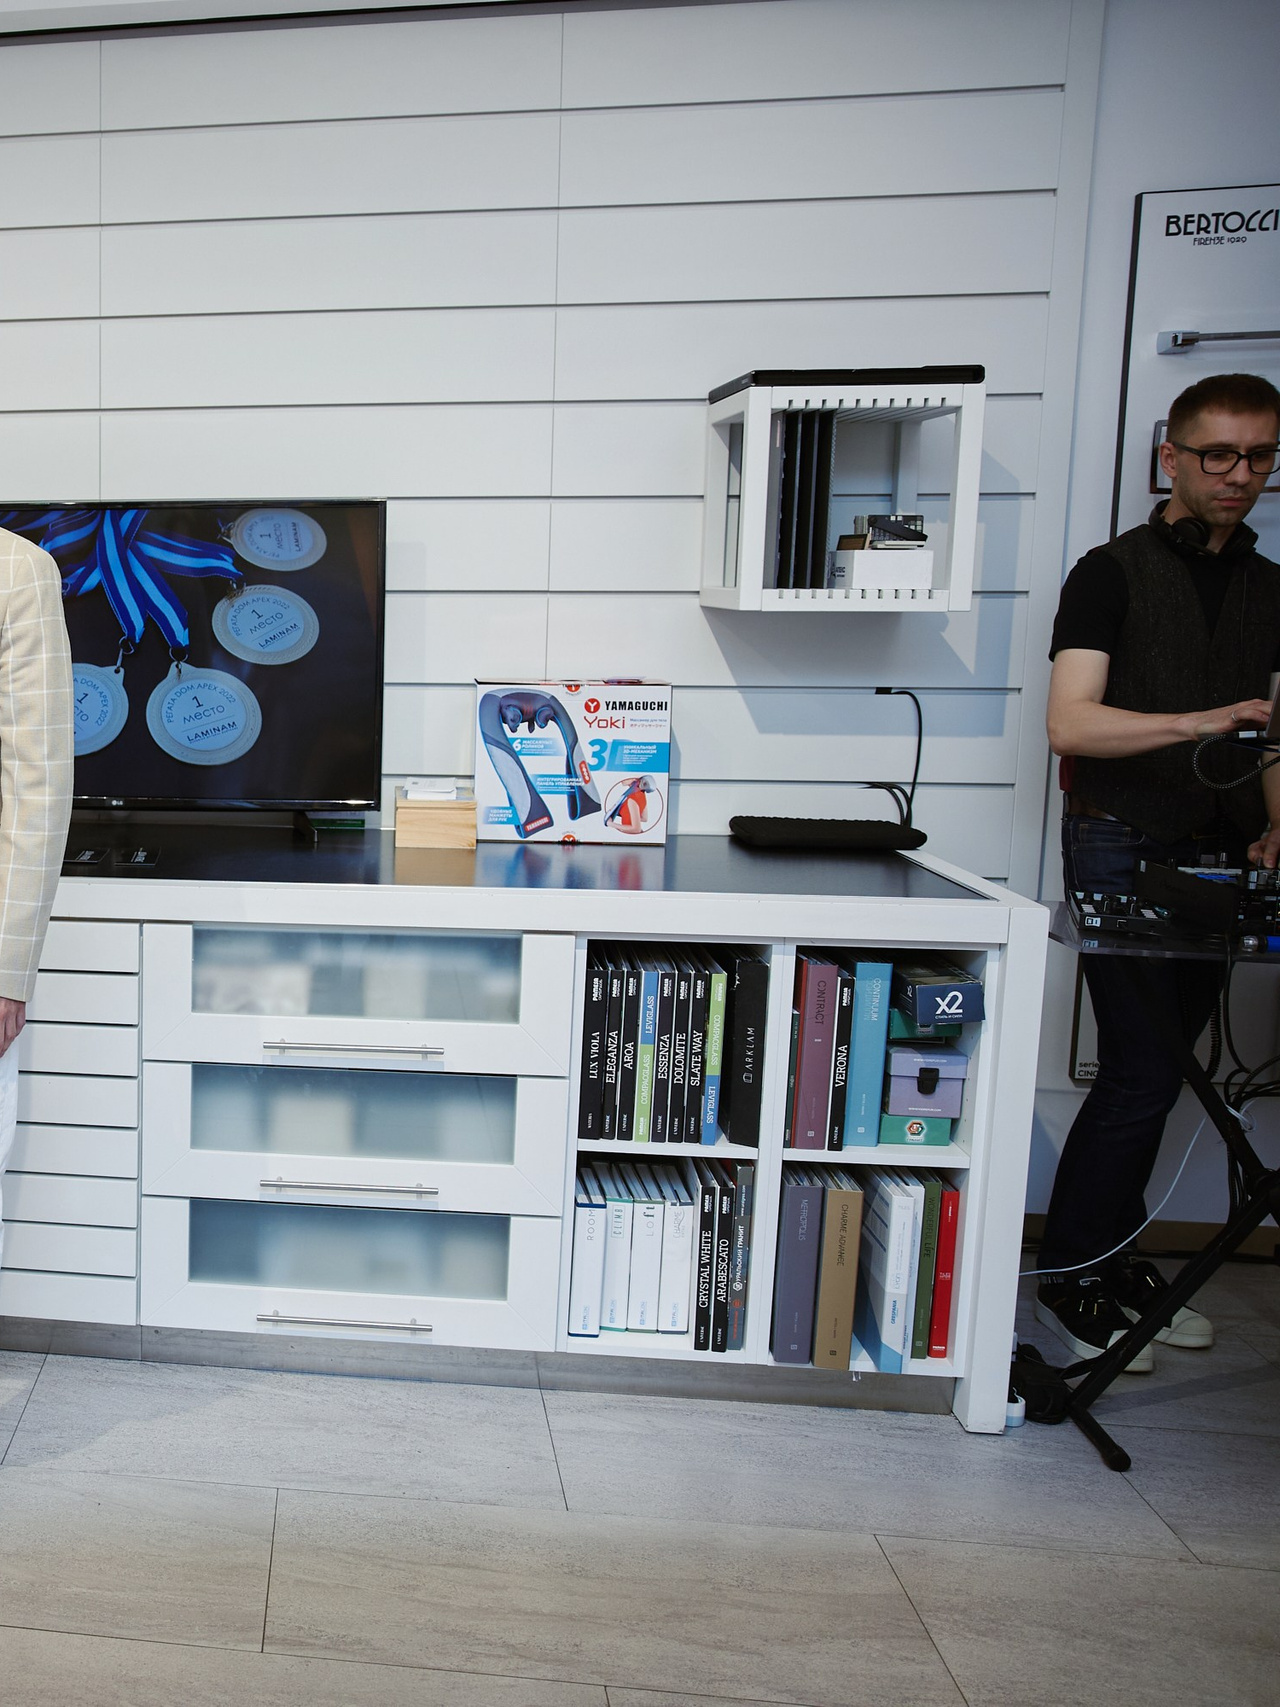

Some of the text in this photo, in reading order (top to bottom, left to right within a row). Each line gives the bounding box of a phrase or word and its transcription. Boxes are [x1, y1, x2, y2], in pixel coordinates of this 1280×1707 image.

[1166, 209, 1280, 236] BERTOCCI
[251, 609, 264, 620] 1
[258, 623, 299, 648] LAMINAM
[77, 692, 89, 704] 1
[80, 678, 100, 691] DOM
[175, 684, 194, 698] DOM
[196, 683, 218, 692] APEX
[219, 688, 236, 703] 2022
[192, 696, 204, 708] 1
[605, 701, 668, 711] YAMAGUCHI
[187, 721, 237, 742] LAMINAM
[584, 716, 625, 729] Yoki
[512, 739, 521, 752] 6
[645, 995, 655, 1034] LEVIGLASS
[815, 981, 827, 1024] CONTRACT
[871, 978, 881, 1021] CONTINUUM
[589, 1031, 600, 1079] LUX VIOLA
[606, 1030, 618, 1083] ELEGANZA
[624, 1042, 634, 1070] AROA
[658, 1034, 670, 1079] ESSENZA
[674, 1033, 686, 1084] DOLOMITE
[691, 1030, 703, 1087] SLATE WAY
[746, 1027, 755, 1070] ARKLAM
[835, 1045, 848, 1087] VERONA
[707, 1086, 716, 1124] LEVIGLASS
[587, 1209, 596, 1241] ROOM
[613, 1208, 623, 1235] CLIMB
[799, 1200, 808, 1241] METROPOLIS
[839, 1204, 848, 1234] CHARME
[737, 1225, 745, 1248] ГРАНИТ
[699, 1230, 712, 1308] CRYSTAL WHITE
[716, 1238, 729, 1302] ARABESCATO
